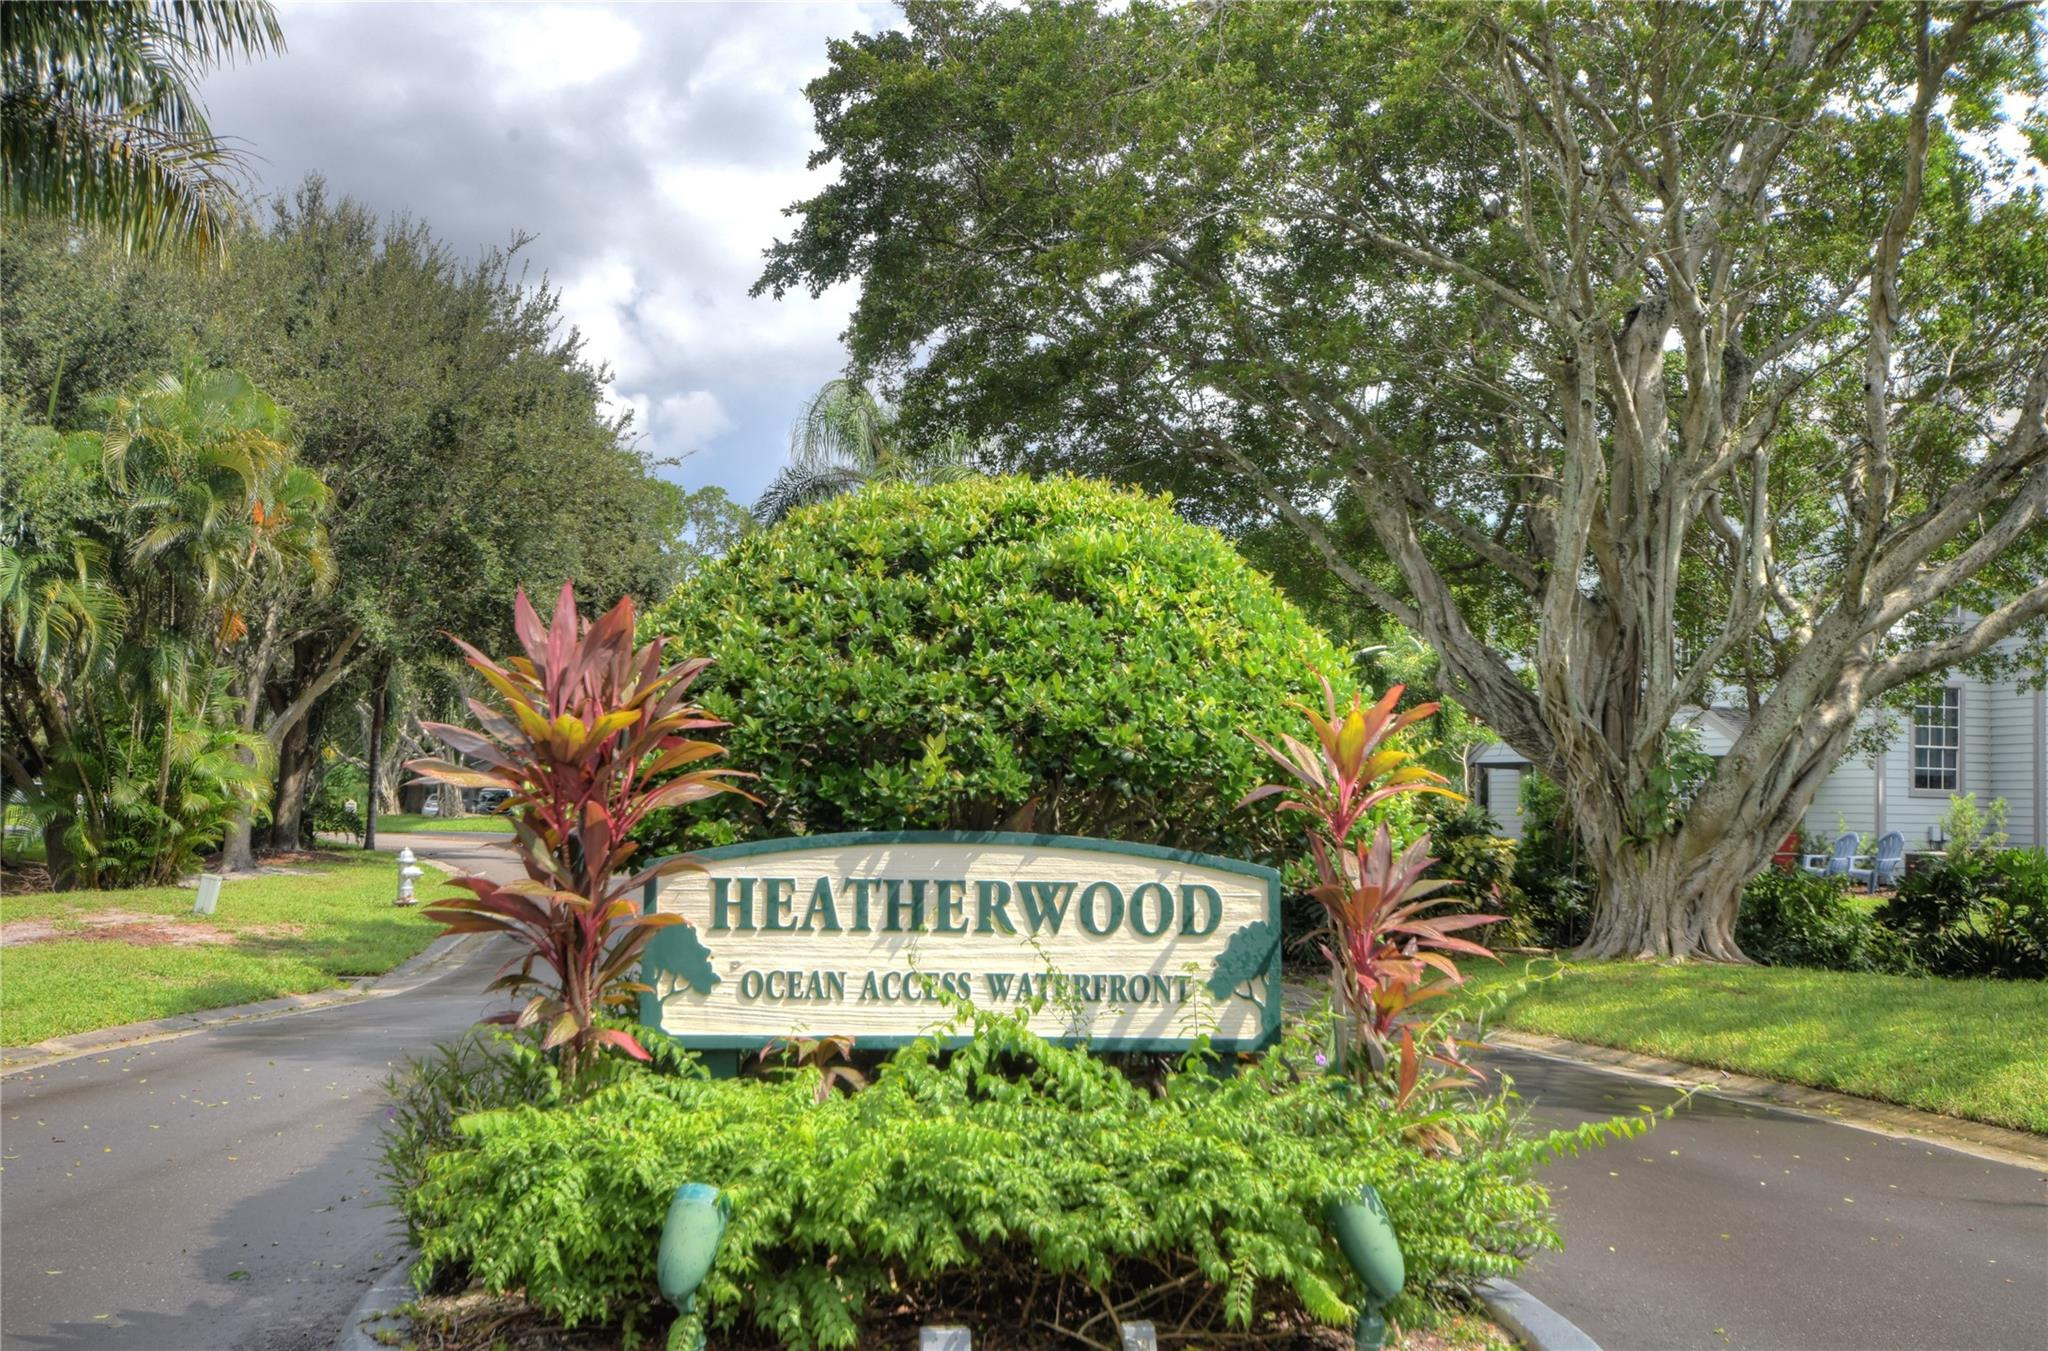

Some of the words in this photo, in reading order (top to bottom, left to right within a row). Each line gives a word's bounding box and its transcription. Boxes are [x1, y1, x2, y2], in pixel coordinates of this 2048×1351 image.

[710, 876, 1223, 937] HEATHERWOOD
[741, 970, 847, 1001] OCEAN
[859, 970, 972, 1001] ACCESS
[985, 971, 1192, 1004] WATERFRONT
